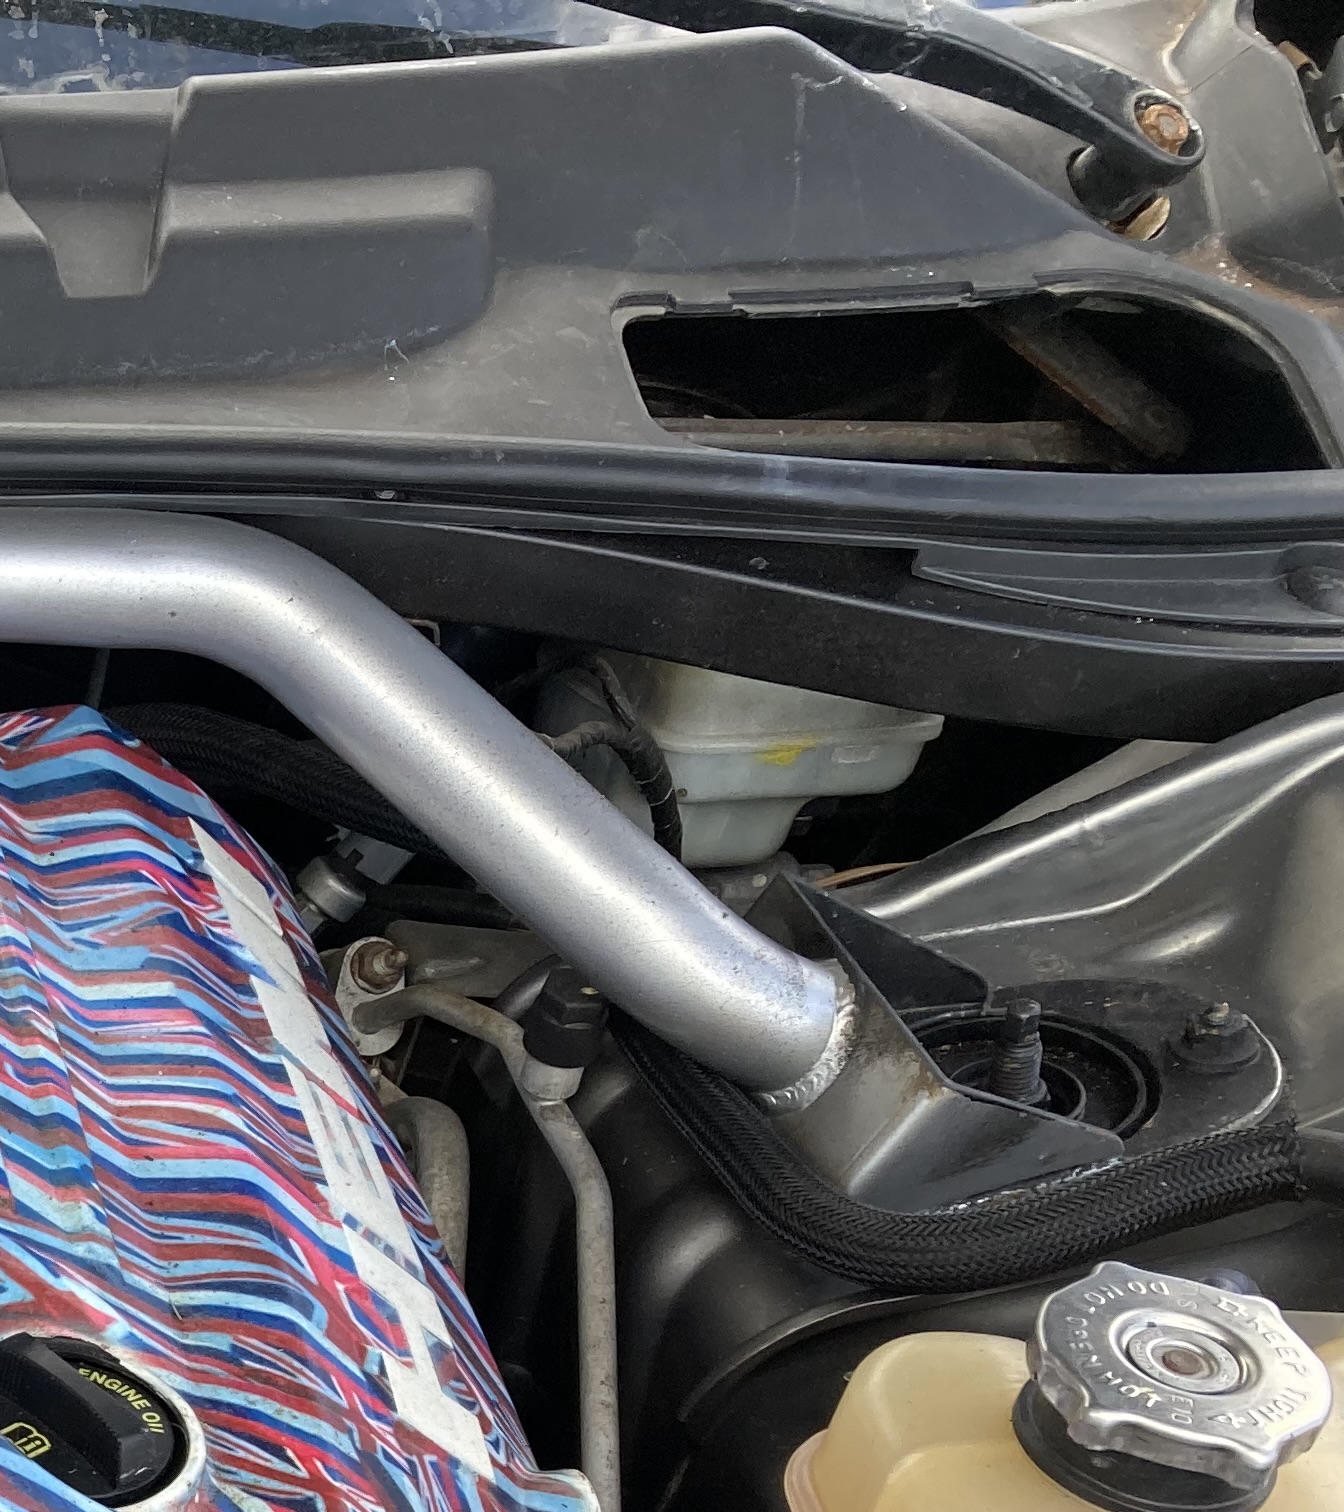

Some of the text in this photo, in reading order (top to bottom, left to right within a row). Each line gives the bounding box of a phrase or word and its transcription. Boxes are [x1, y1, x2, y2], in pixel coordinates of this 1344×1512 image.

[1246, 1312, 1310, 1377] KEEP
[78, 1367, 152, 1410] ENGINE
[1097, 1371, 1161, 1408] HOT
